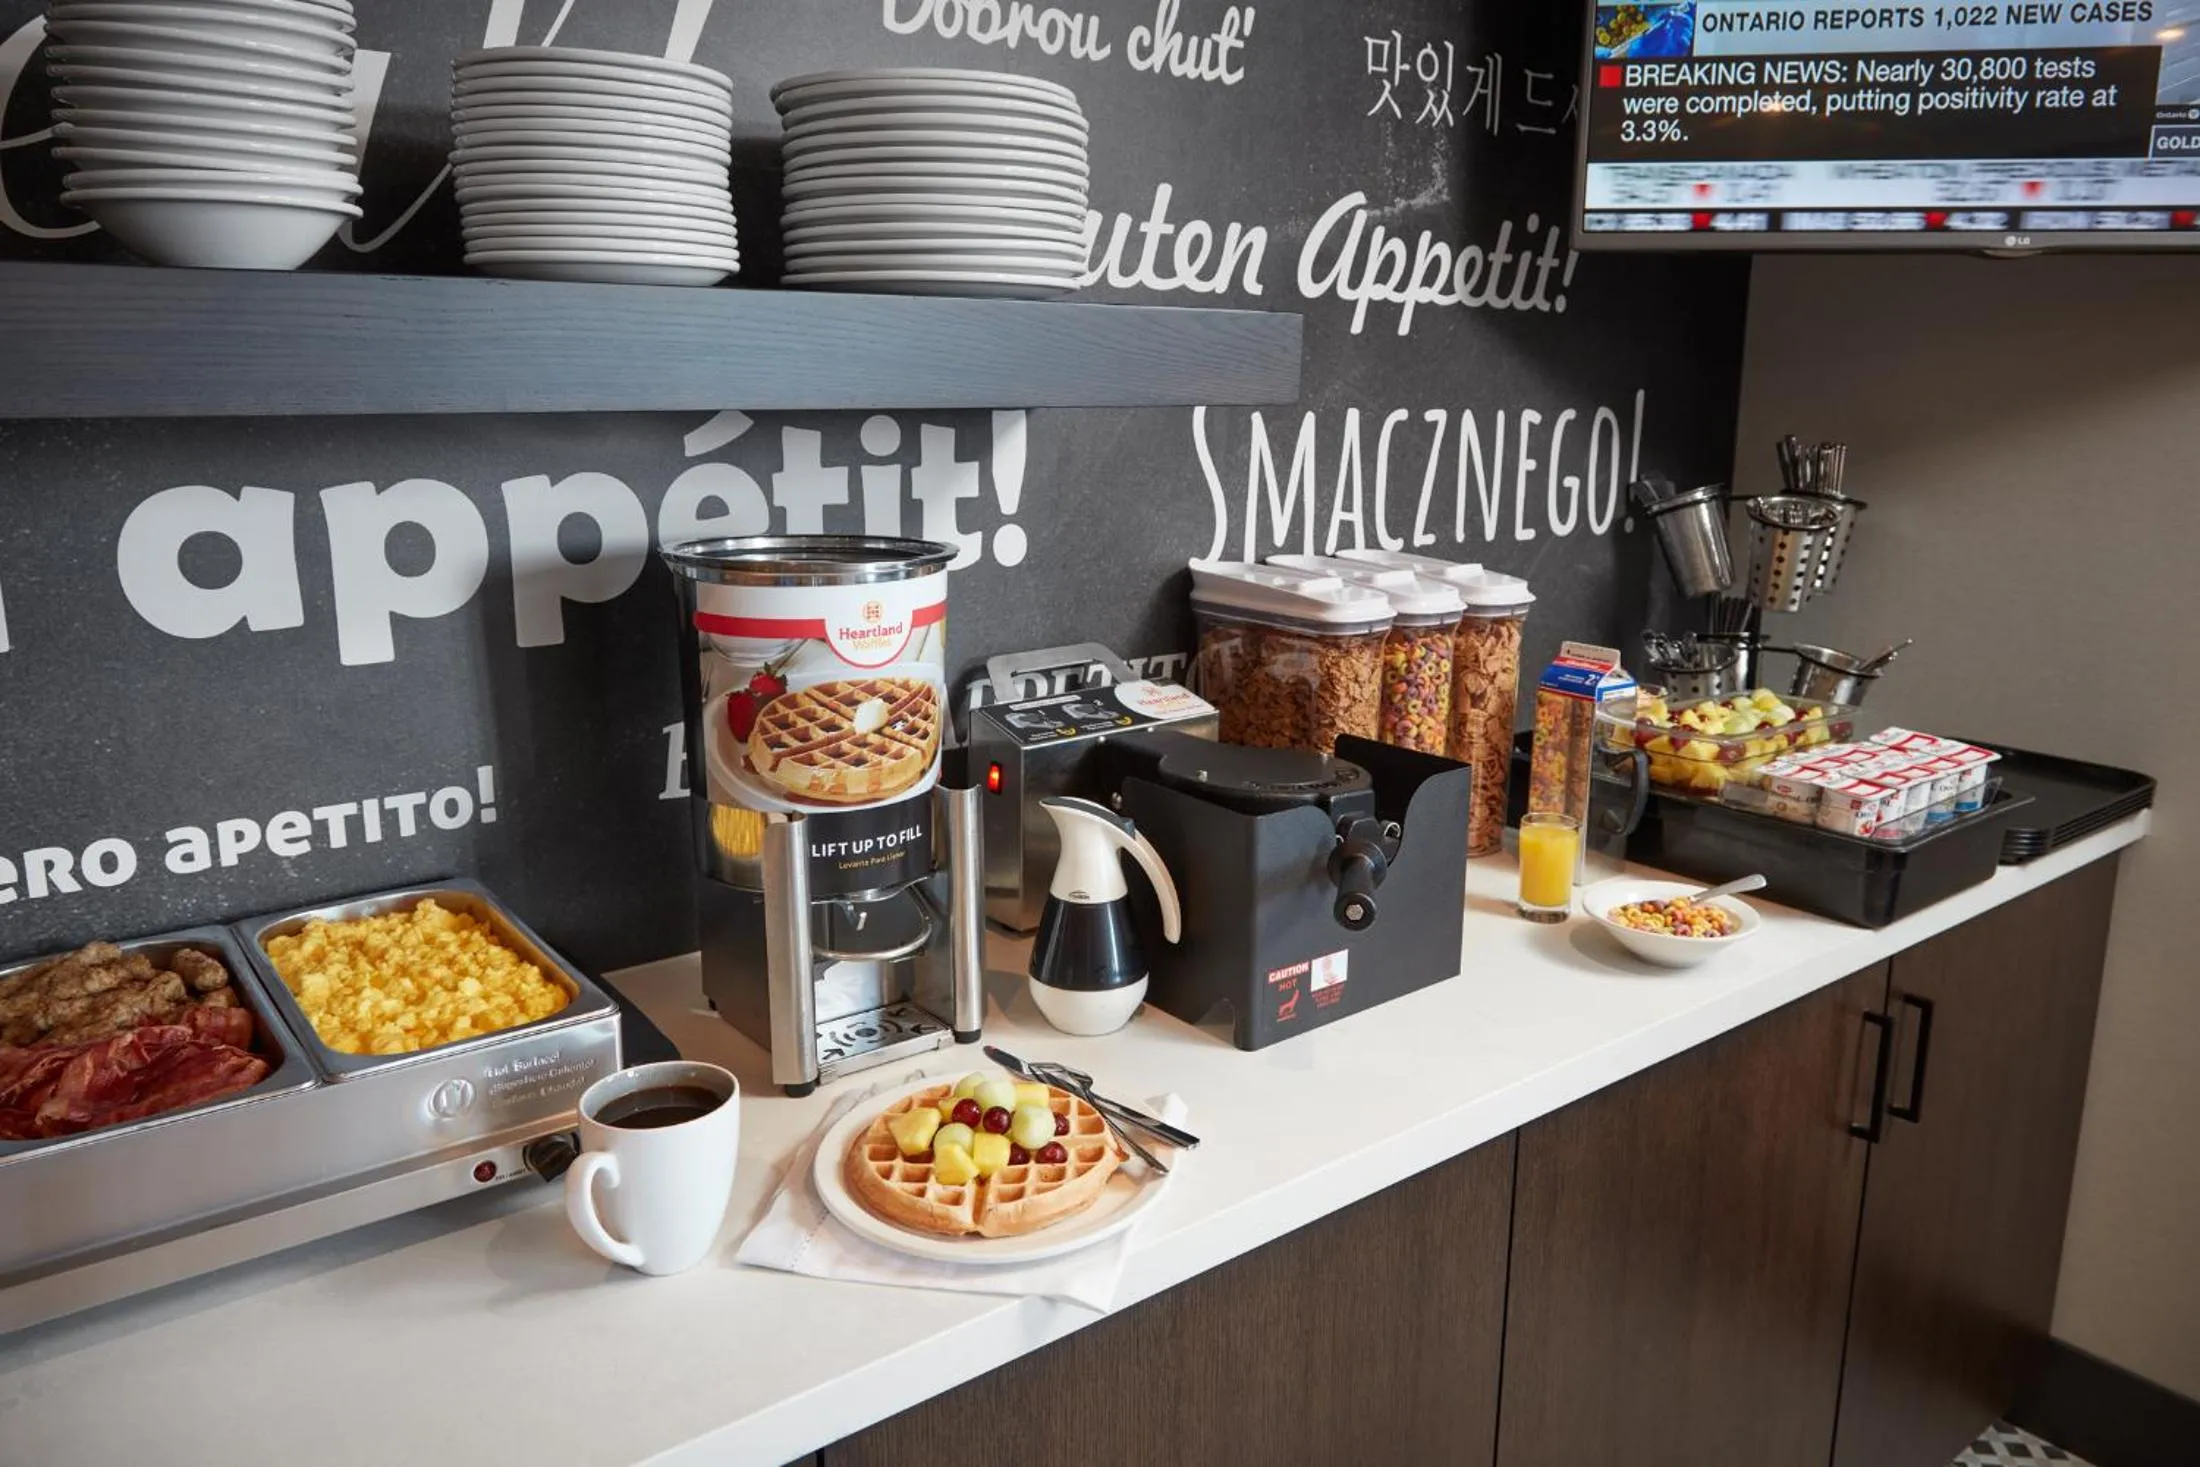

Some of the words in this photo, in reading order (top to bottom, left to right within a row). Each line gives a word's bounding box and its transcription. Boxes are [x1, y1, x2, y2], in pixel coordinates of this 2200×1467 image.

[1702, 11, 1805, 33] ONTARIO
[1813, 7, 1924, 31] REPORTS
[1934, 5, 1998, 30] 1,022
[2005, 3, 2062, 25] NEW
[2069, 1, 2153, 24] CASES
[1363, 29, 1503, 137] 맛있게
[1624, 61, 1756, 87] BREAKING
[1763, 59, 1848, 85] NEWS:
[1855, 57, 1935, 87] Nearly
[1940, 56, 2027, 84] 30,800
[2034, 56, 2097, 79] tests
[1623, 95, 1679, 115] were
[1685, 89, 1817, 118] completed,
[1825, 87, 1910, 117] putting
[1917, 86, 2029, 116] positivity
[2034, 85, 2085, 108] rate
[2091, 84, 2118, 107] at
[1620, 119, 1689, 143] 3.3%.
[2156, 135, 2200, 150] GOLD
[1078, 183, 1267, 296] uten
[1296, 190, 1578, 336] Appetit!
[1189, 389, 1645, 564] SMACZNEGO!
[117, 409, 1028, 667] appétit!
[839, 622, 903, 641] Heartland
[811, 842, 849, 858] LIFT
[852, 839, 874, 854] UP
[876, 834, 897, 850] TO
[899, 824, 923, 845] FILL
[1268, 961, 1310, 984] CAUTION
